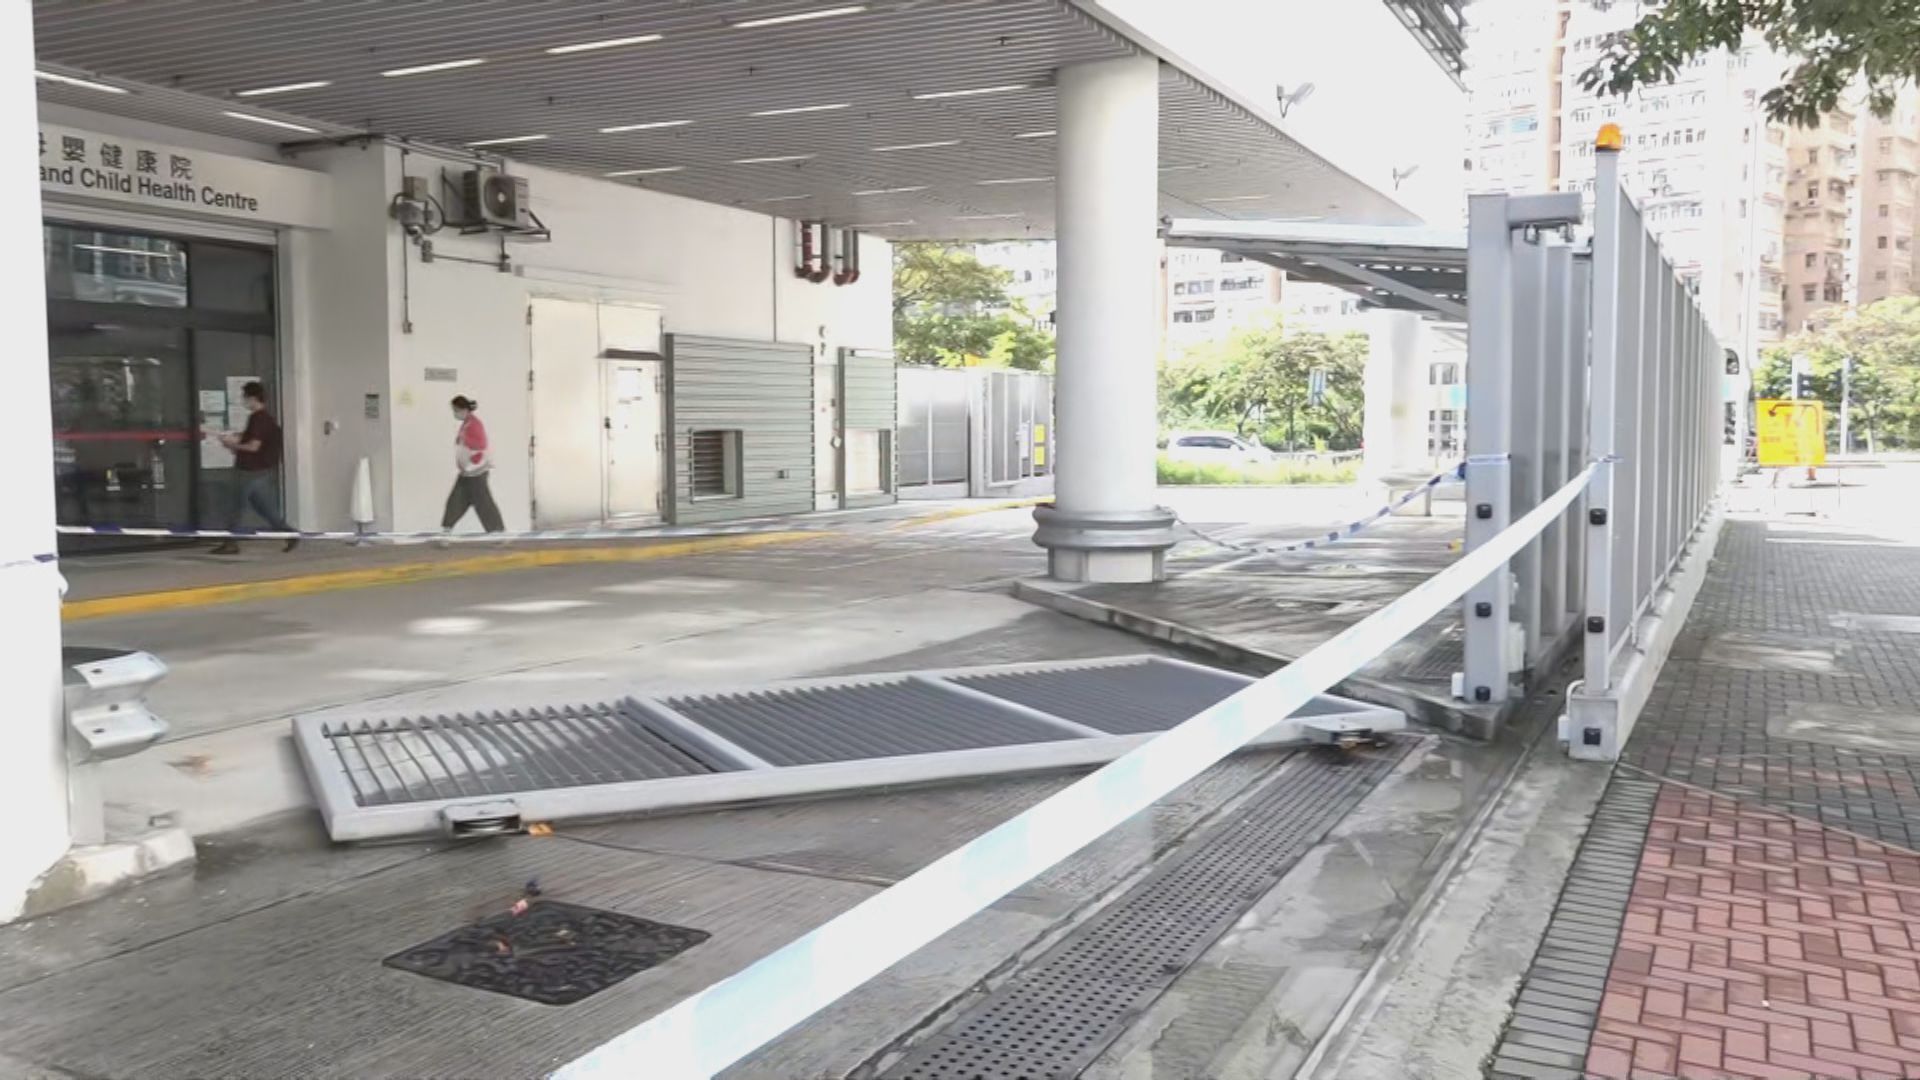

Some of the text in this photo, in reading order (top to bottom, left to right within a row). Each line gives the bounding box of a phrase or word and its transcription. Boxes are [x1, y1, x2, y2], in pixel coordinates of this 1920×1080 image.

[39, 166, 258, 211] and Child Health Centre
